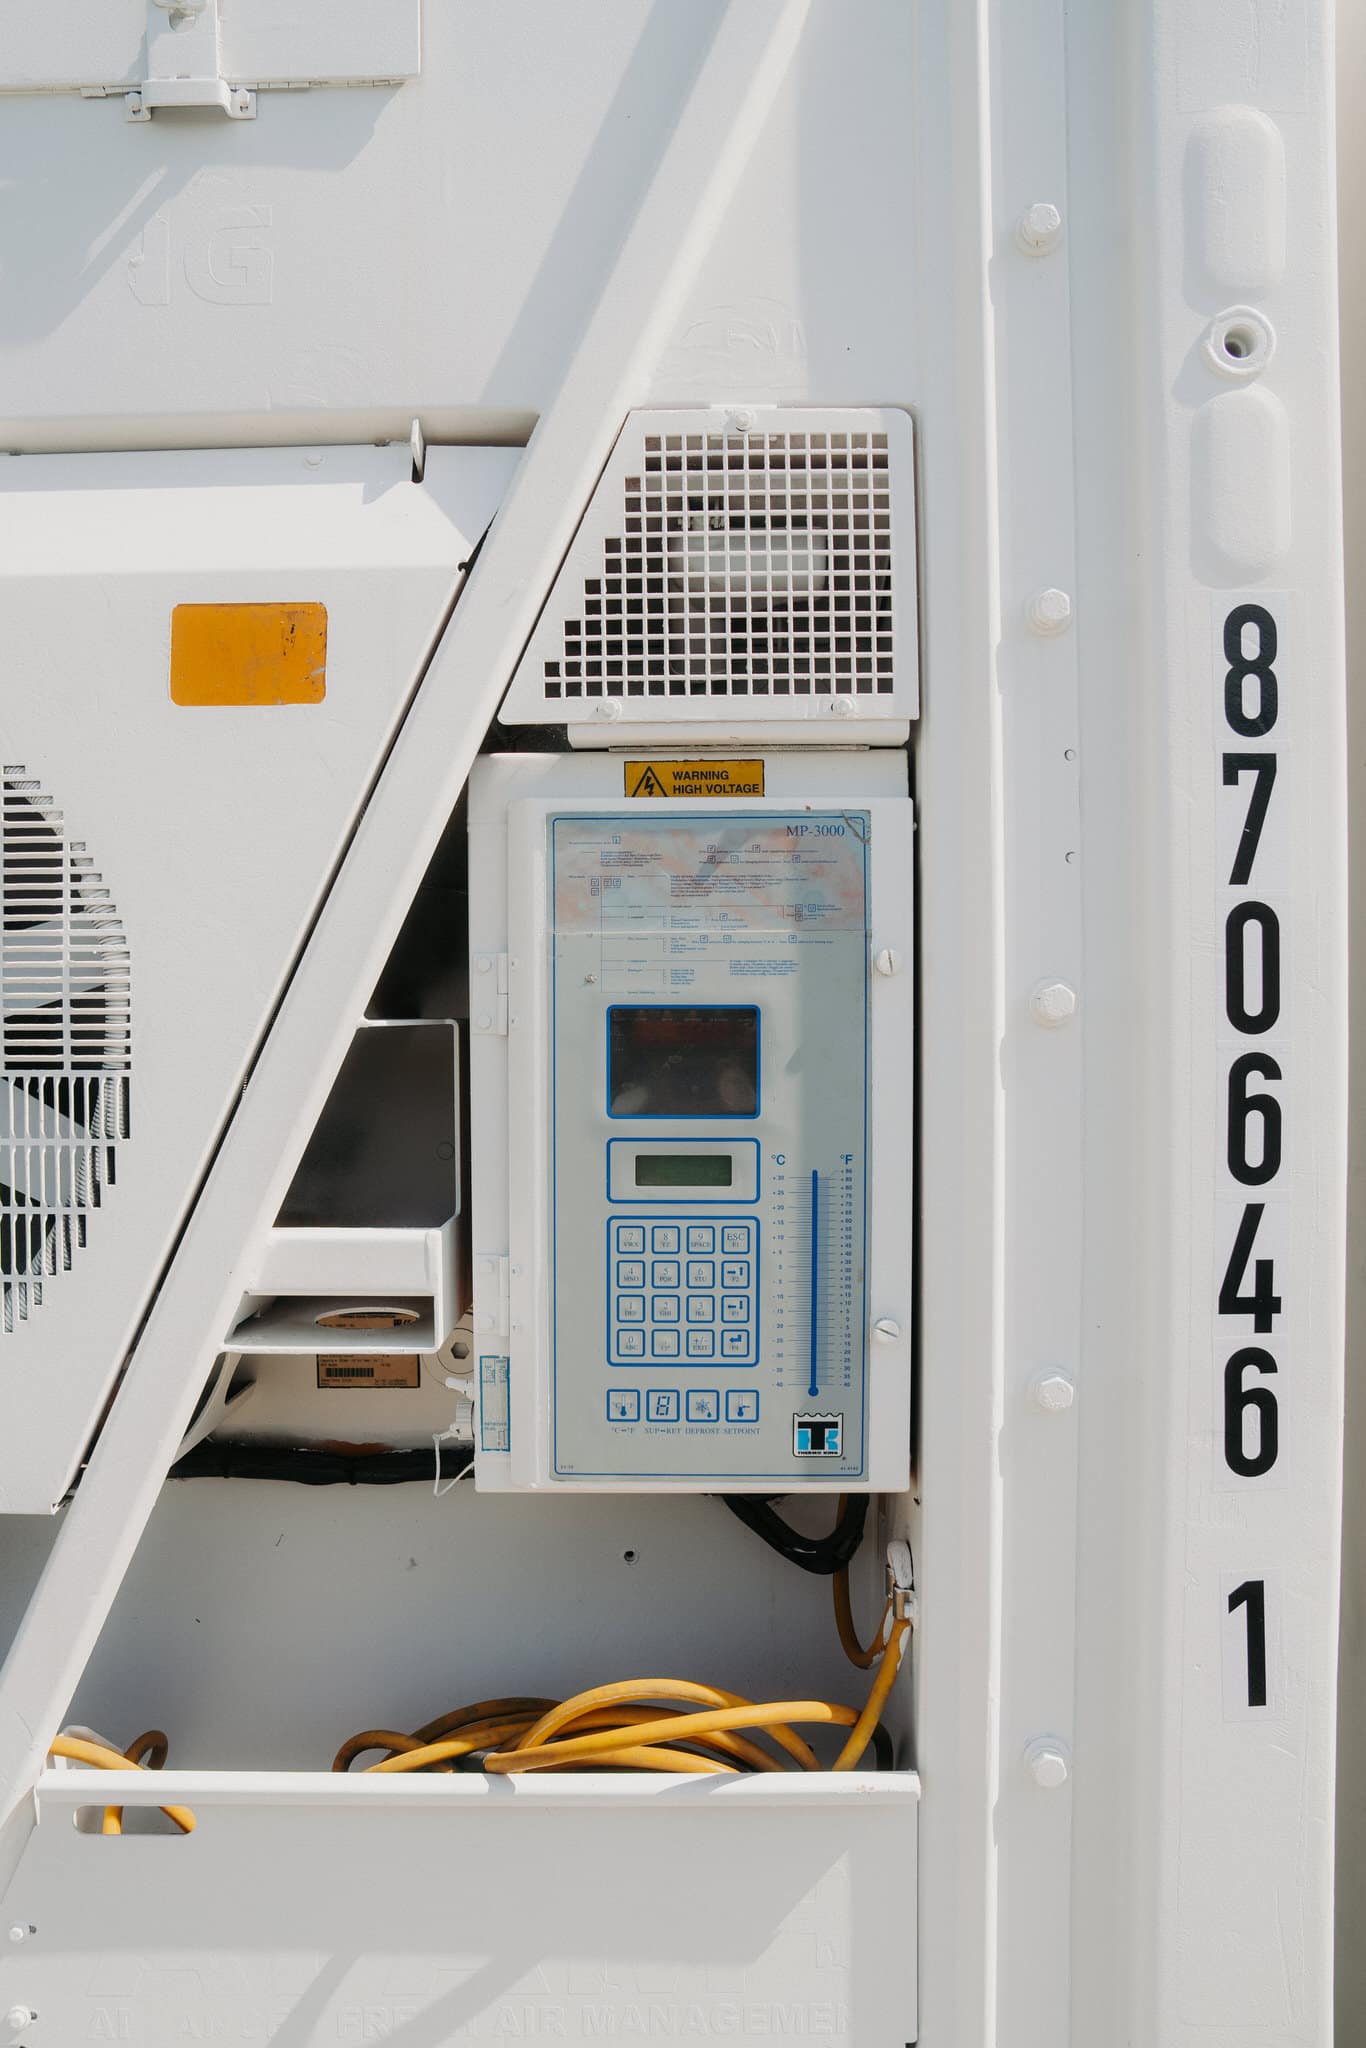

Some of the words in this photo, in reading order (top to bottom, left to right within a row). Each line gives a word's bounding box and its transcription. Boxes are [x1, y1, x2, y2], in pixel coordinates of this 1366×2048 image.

[672, 770, 729, 780] WARNING
[673, 784, 702, 794] HIGH
[706, 783, 760, 794] VOLTAGE
[785, 824, 845, 838] MP-3000
[727, 1232, 744, 1241] ESC
[685, 1427, 720, 1435] DEFROST
[724, 1427, 760, 1435] SETPOINT
[1228, 1580, 1266, 1707] 1
